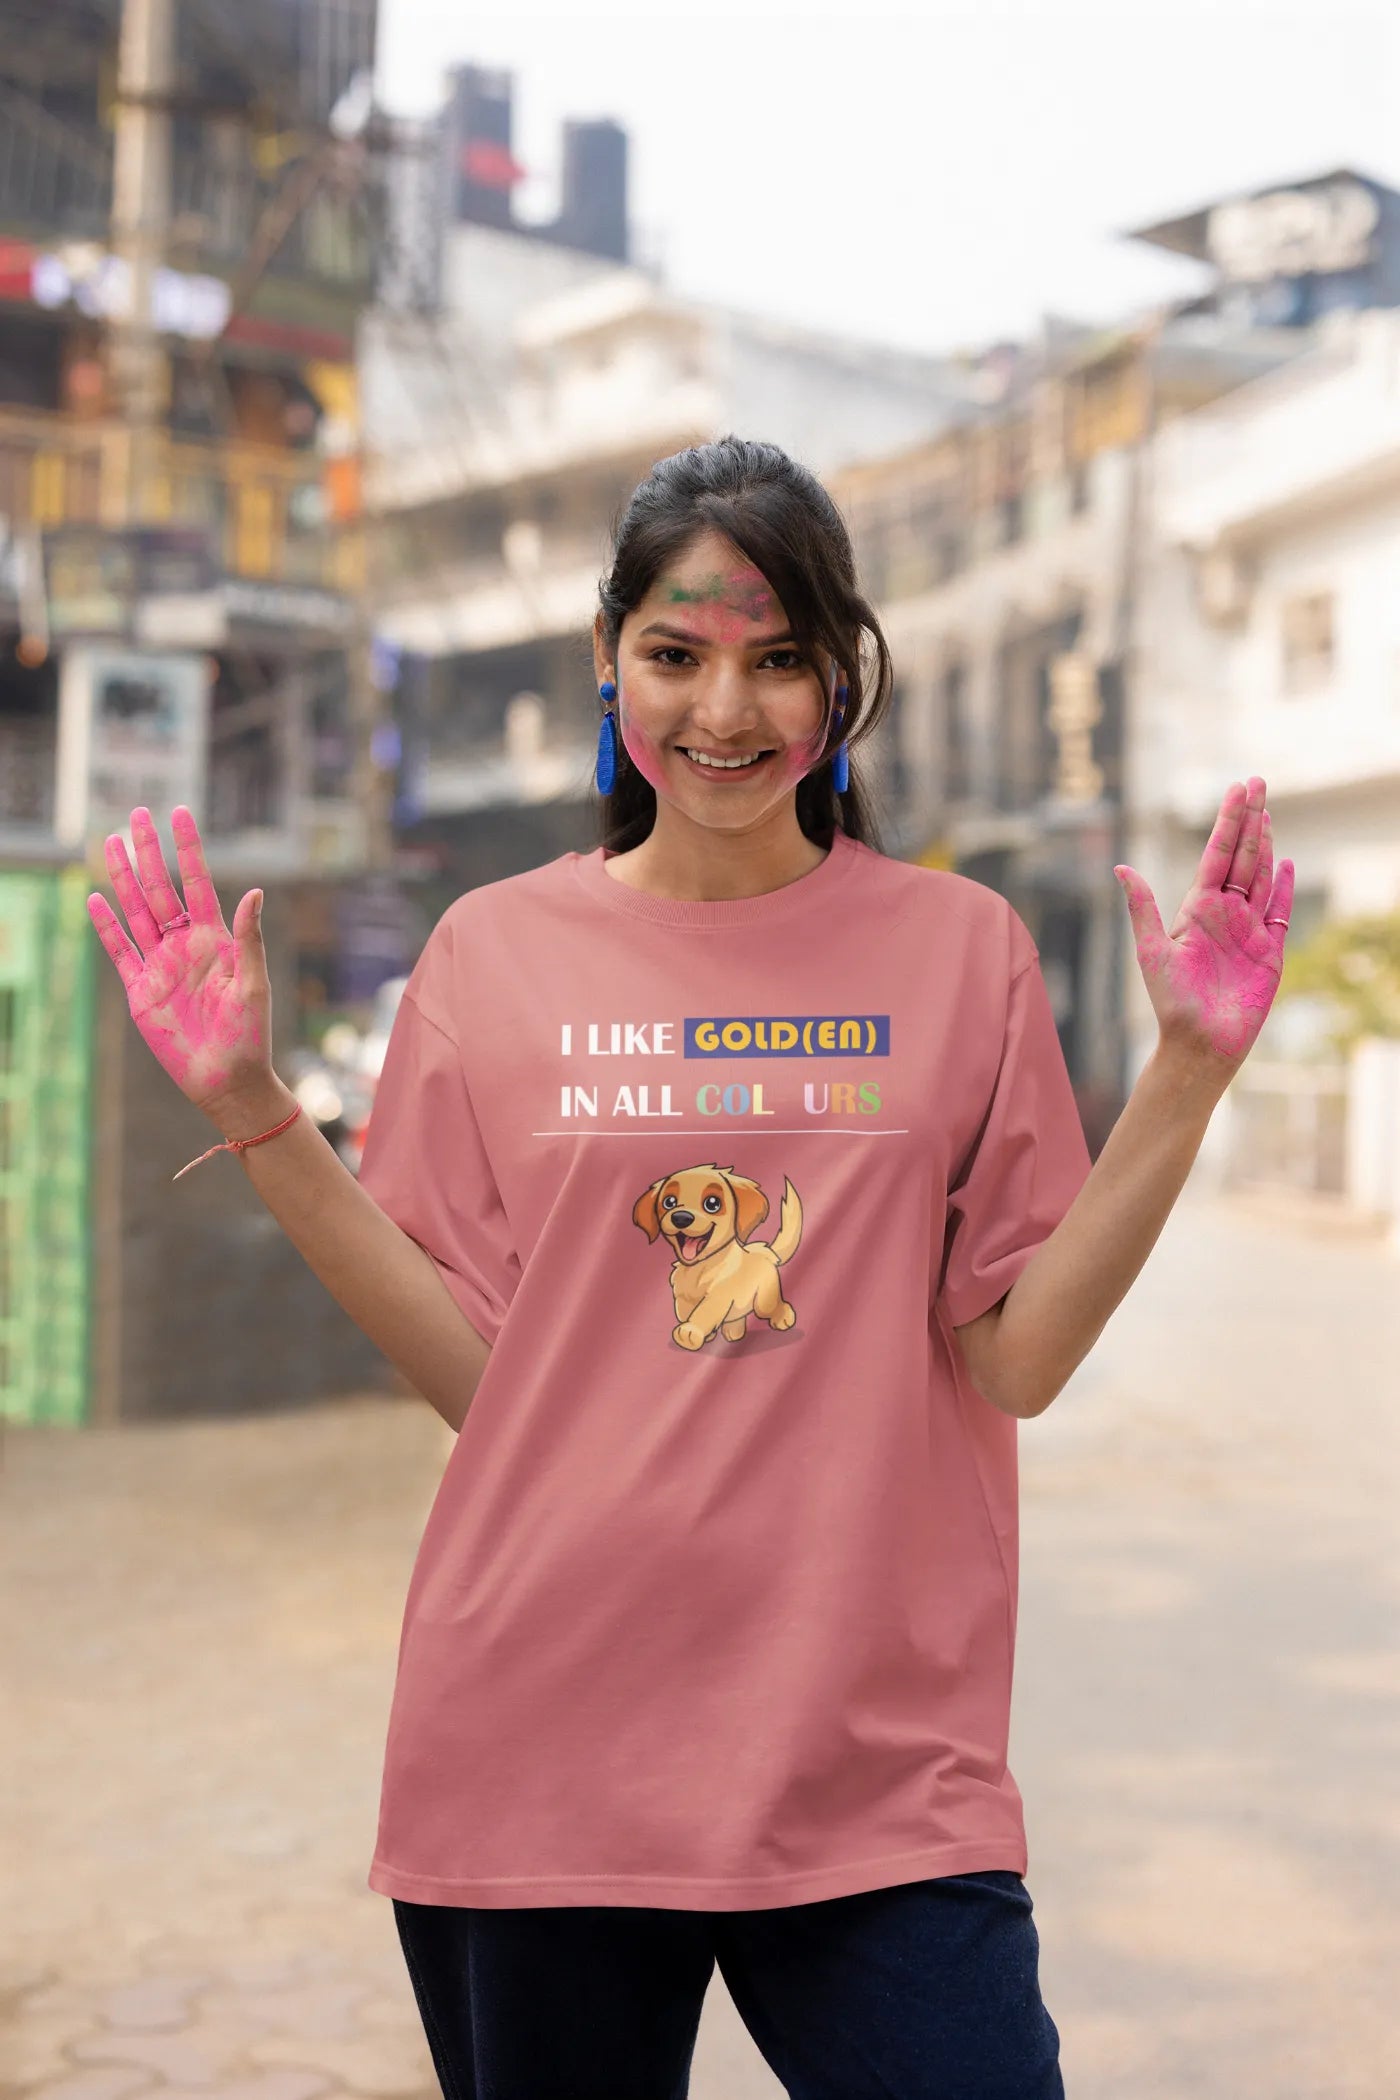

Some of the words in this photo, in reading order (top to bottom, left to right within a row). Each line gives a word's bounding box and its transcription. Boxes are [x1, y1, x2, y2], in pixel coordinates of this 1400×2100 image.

[561, 1024, 572, 1055] I
[588, 1023, 675, 1055] LIKE
[561, 1086, 598, 1117] IN
[612, 1085, 683, 1117] ALL
